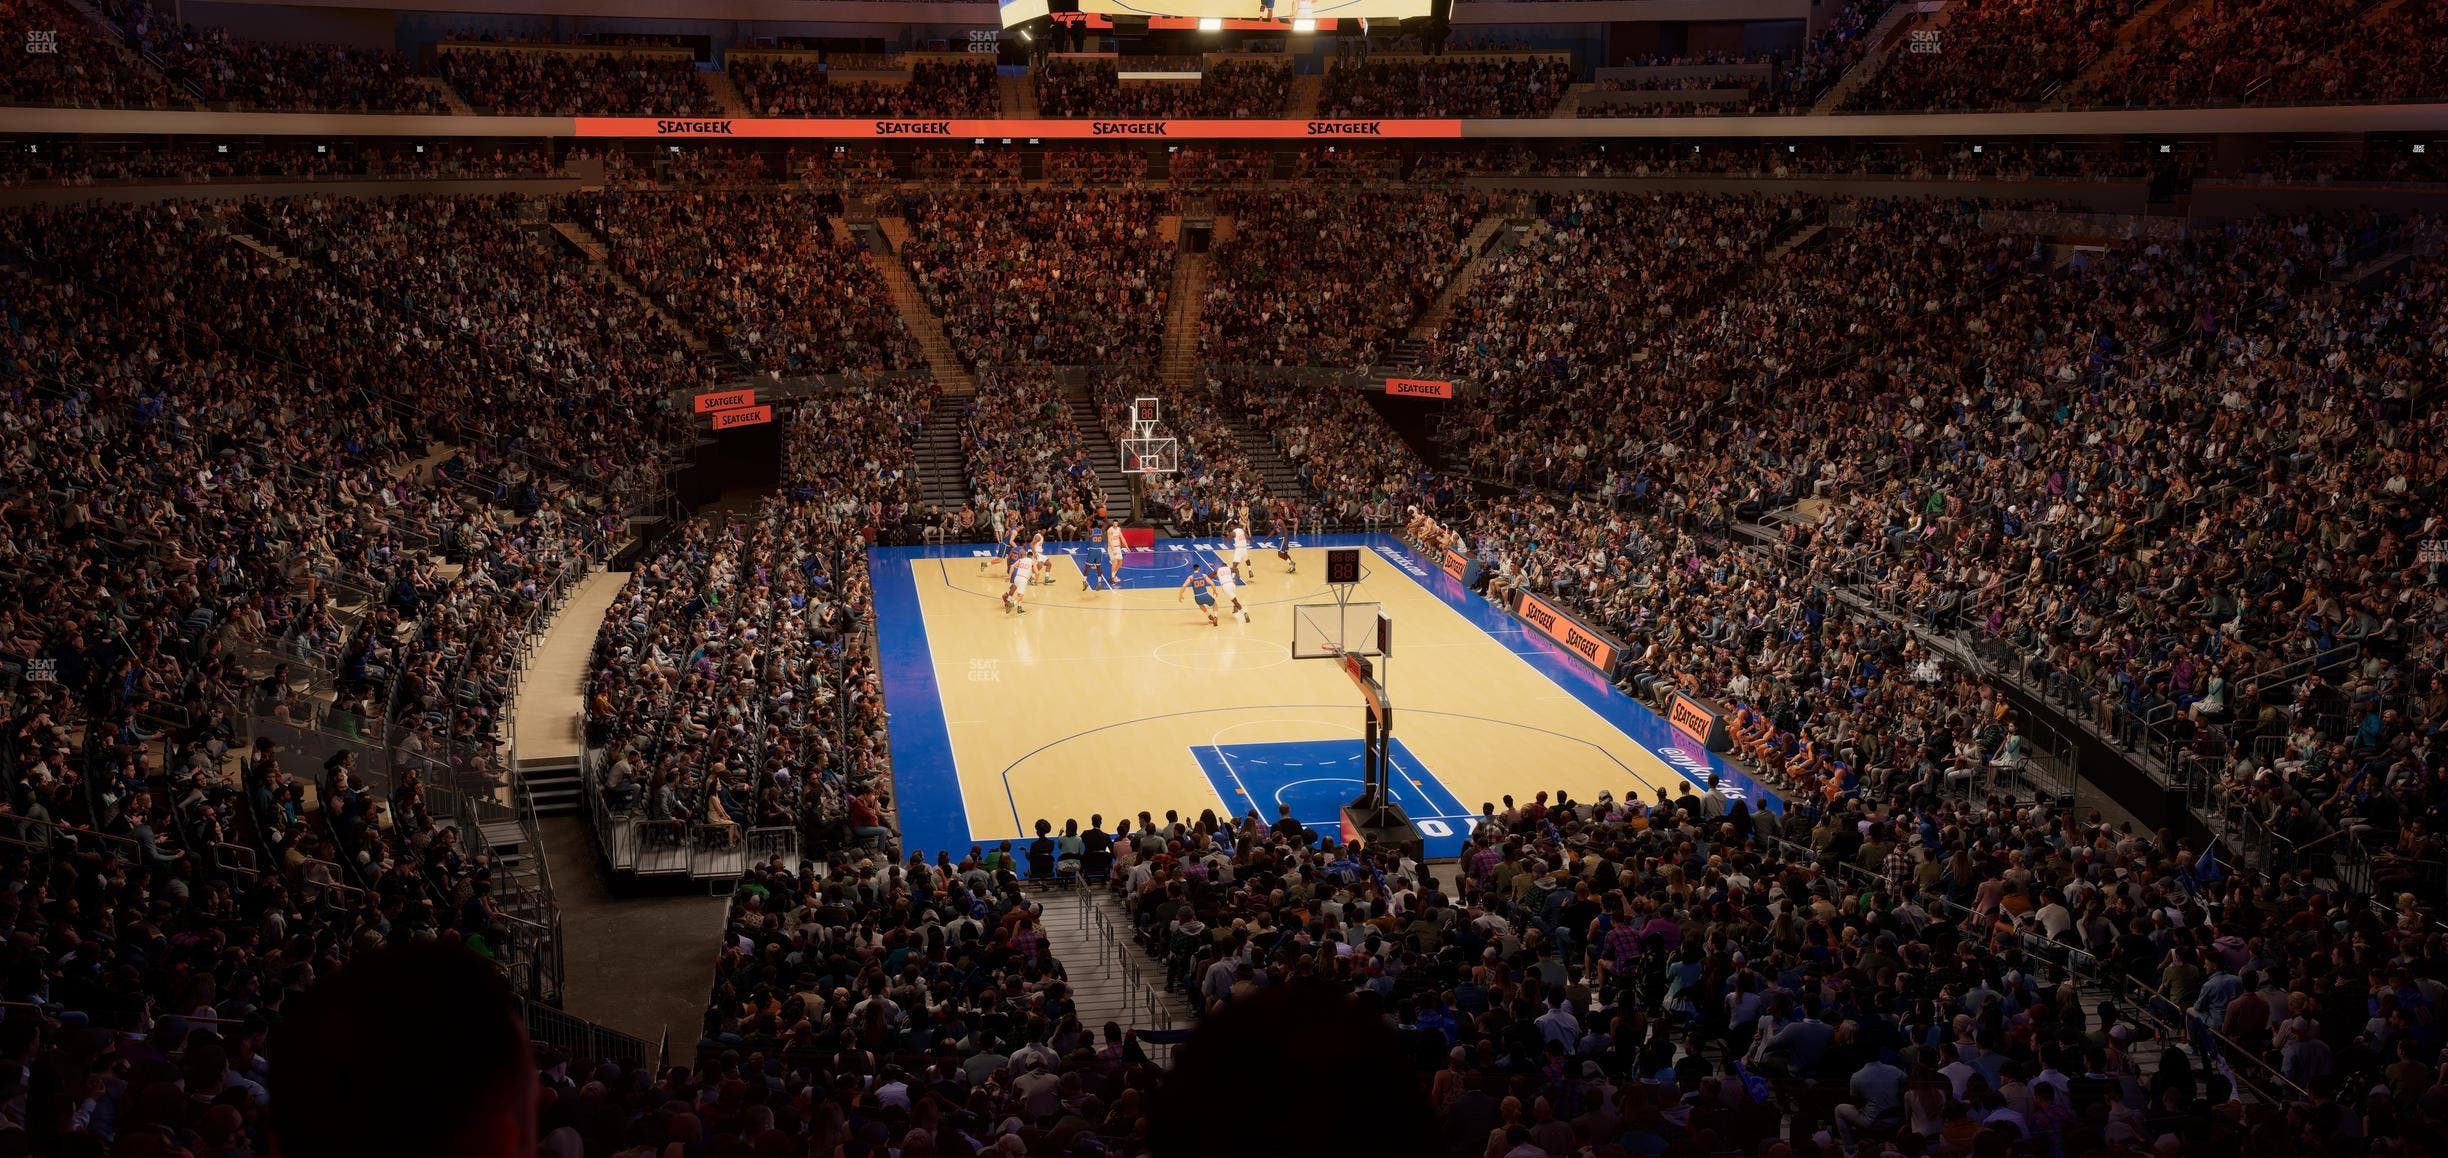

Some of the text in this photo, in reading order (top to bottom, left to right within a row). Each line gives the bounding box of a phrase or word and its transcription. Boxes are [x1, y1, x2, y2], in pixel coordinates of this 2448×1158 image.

[657, 120, 732, 135] SEATGEEK
[876, 121, 951, 135] SEATGEEK
[1092, 122, 1167, 135] SEATGEEK
[1307, 121, 1381, 135] SEATGEEK
[1397, 382, 1441, 395] SEATGEEK
[704, 394, 744, 409] SEATGEEK
[722, 411, 761, 426] SEATGEEK
[1168, 541, 1303, 552] KNIKS
[1525, 602, 1556, 633] SEATGEEK
[1565, 628, 1600, 662] SEATGEEK
[1673, 702, 1709, 739] SEATGEEK
